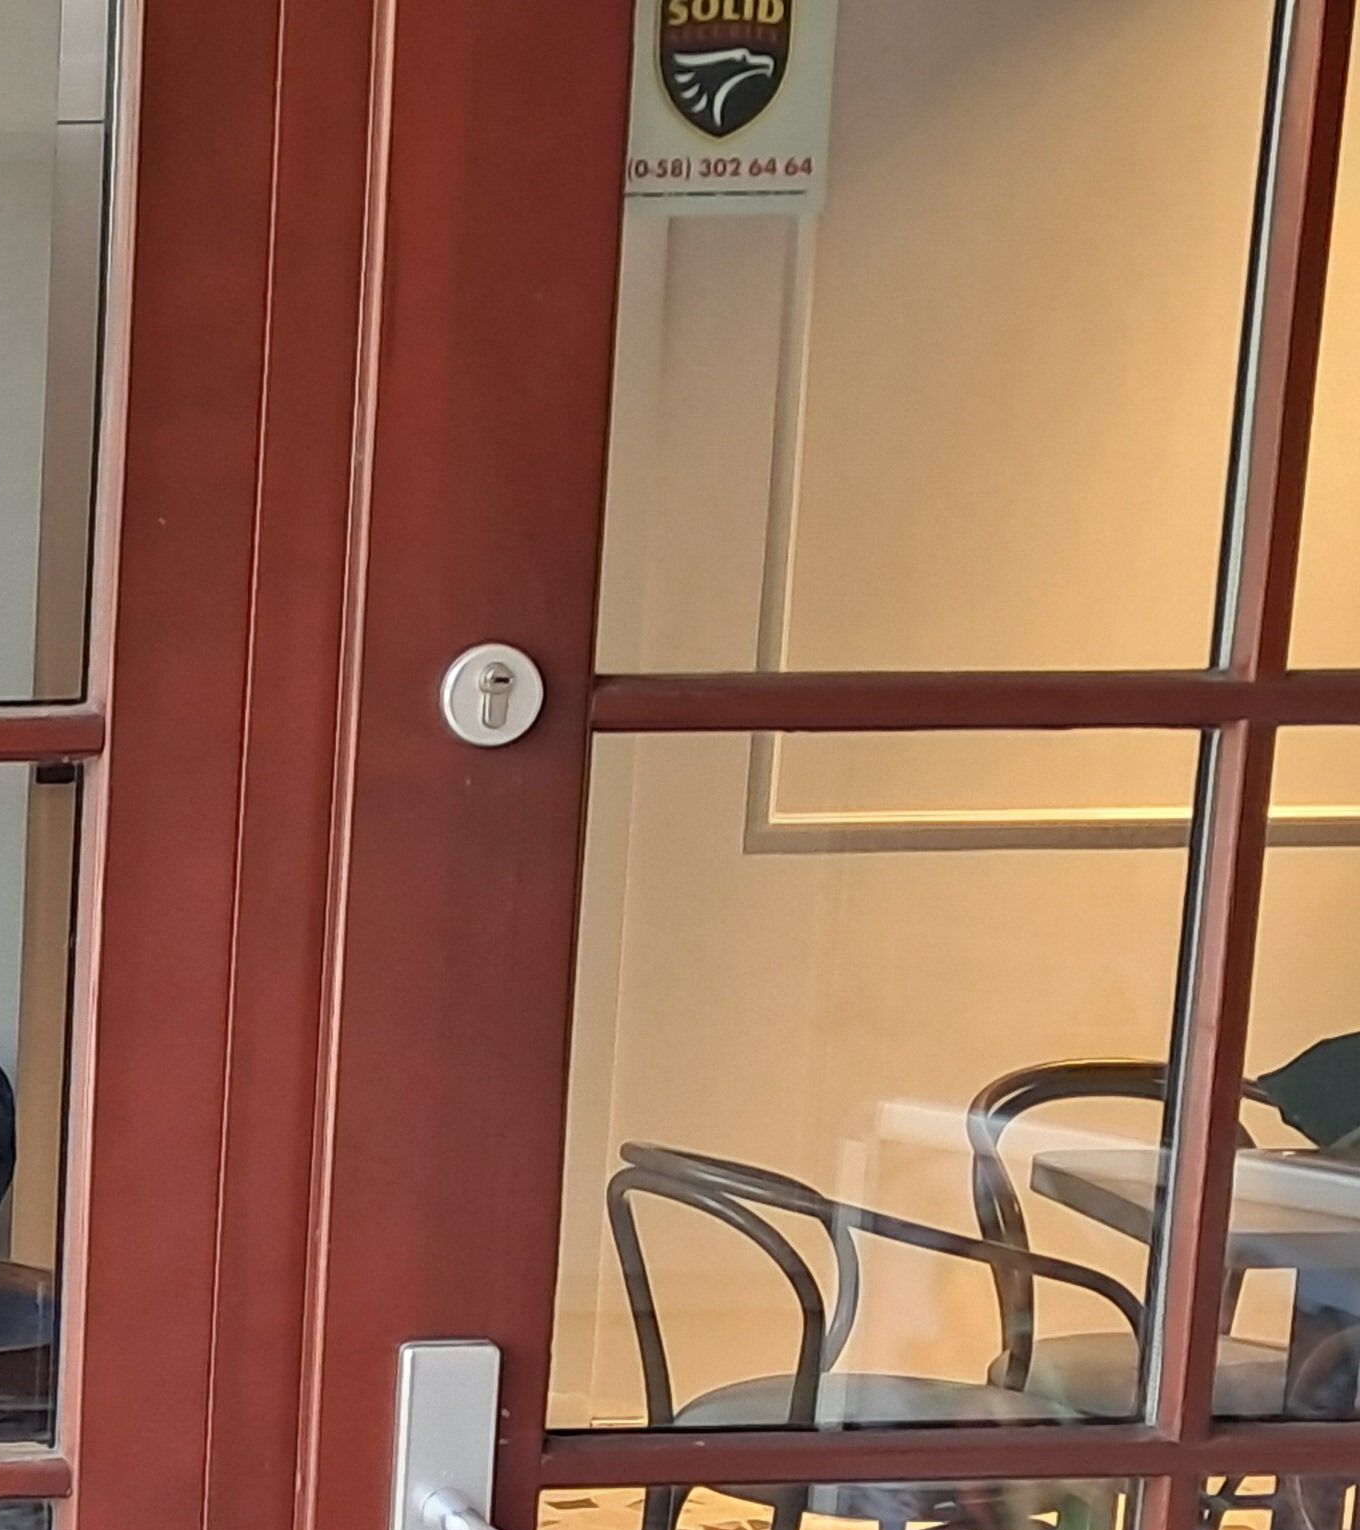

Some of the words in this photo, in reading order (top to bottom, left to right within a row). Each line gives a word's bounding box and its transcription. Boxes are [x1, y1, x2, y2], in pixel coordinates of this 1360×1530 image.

[668, 0, 785, 25] SOLID
[698, 157, 742, 178] 302
[748, 157, 778, 177] 64
[784, 156, 813, 177] 64
